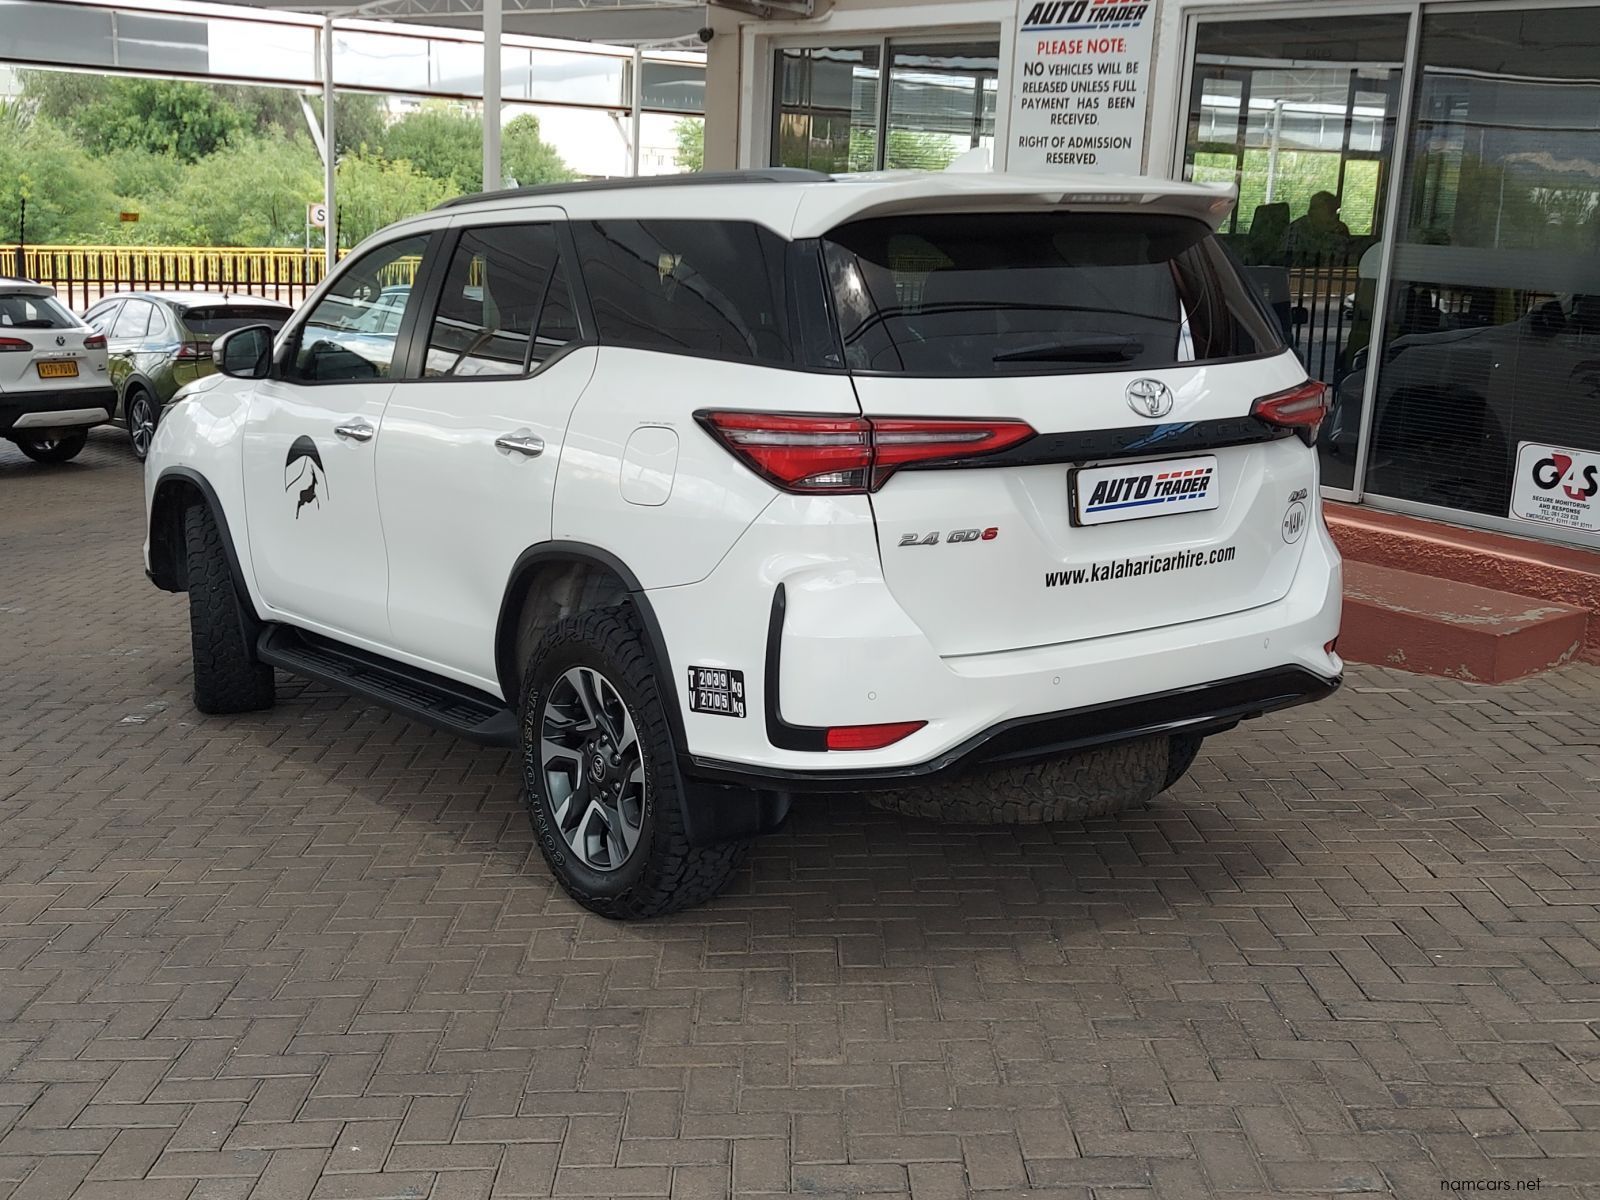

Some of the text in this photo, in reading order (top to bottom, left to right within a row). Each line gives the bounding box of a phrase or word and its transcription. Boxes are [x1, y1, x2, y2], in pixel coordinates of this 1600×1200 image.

[1023, 2, 1148, 25] AUTO TRADER
[1037, 38, 1126, 55] PLEASE NOTE:
[1023, 61, 1139, 76] NO VEHICLES WILL BE
[1022, 79, 1137, 94] RELEASED UNLESS FULL
[1021, 96, 1135, 110] PAYMENT HAS BEEN
[1050, 113, 1100, 125] RECEIVED.
[1018, 136, 1132, 149] RIGHT OF ADMISSION
[1046, 152, 1099, 165] RESERVED.
[1532, 453, 1598, 502] G4S
[1088, 474, 1211, 506] AUTO TRADER
[1532, 495, 1591, 510] SECURE MONITORING
[897, 531, 940, 548] 2.4
[1045, 546, 1236, 588] www.kalaharicarhire.com
[688, 669, 743, 698] T 2039 kg
[689, 690, 744, 718] V 2705 kg
